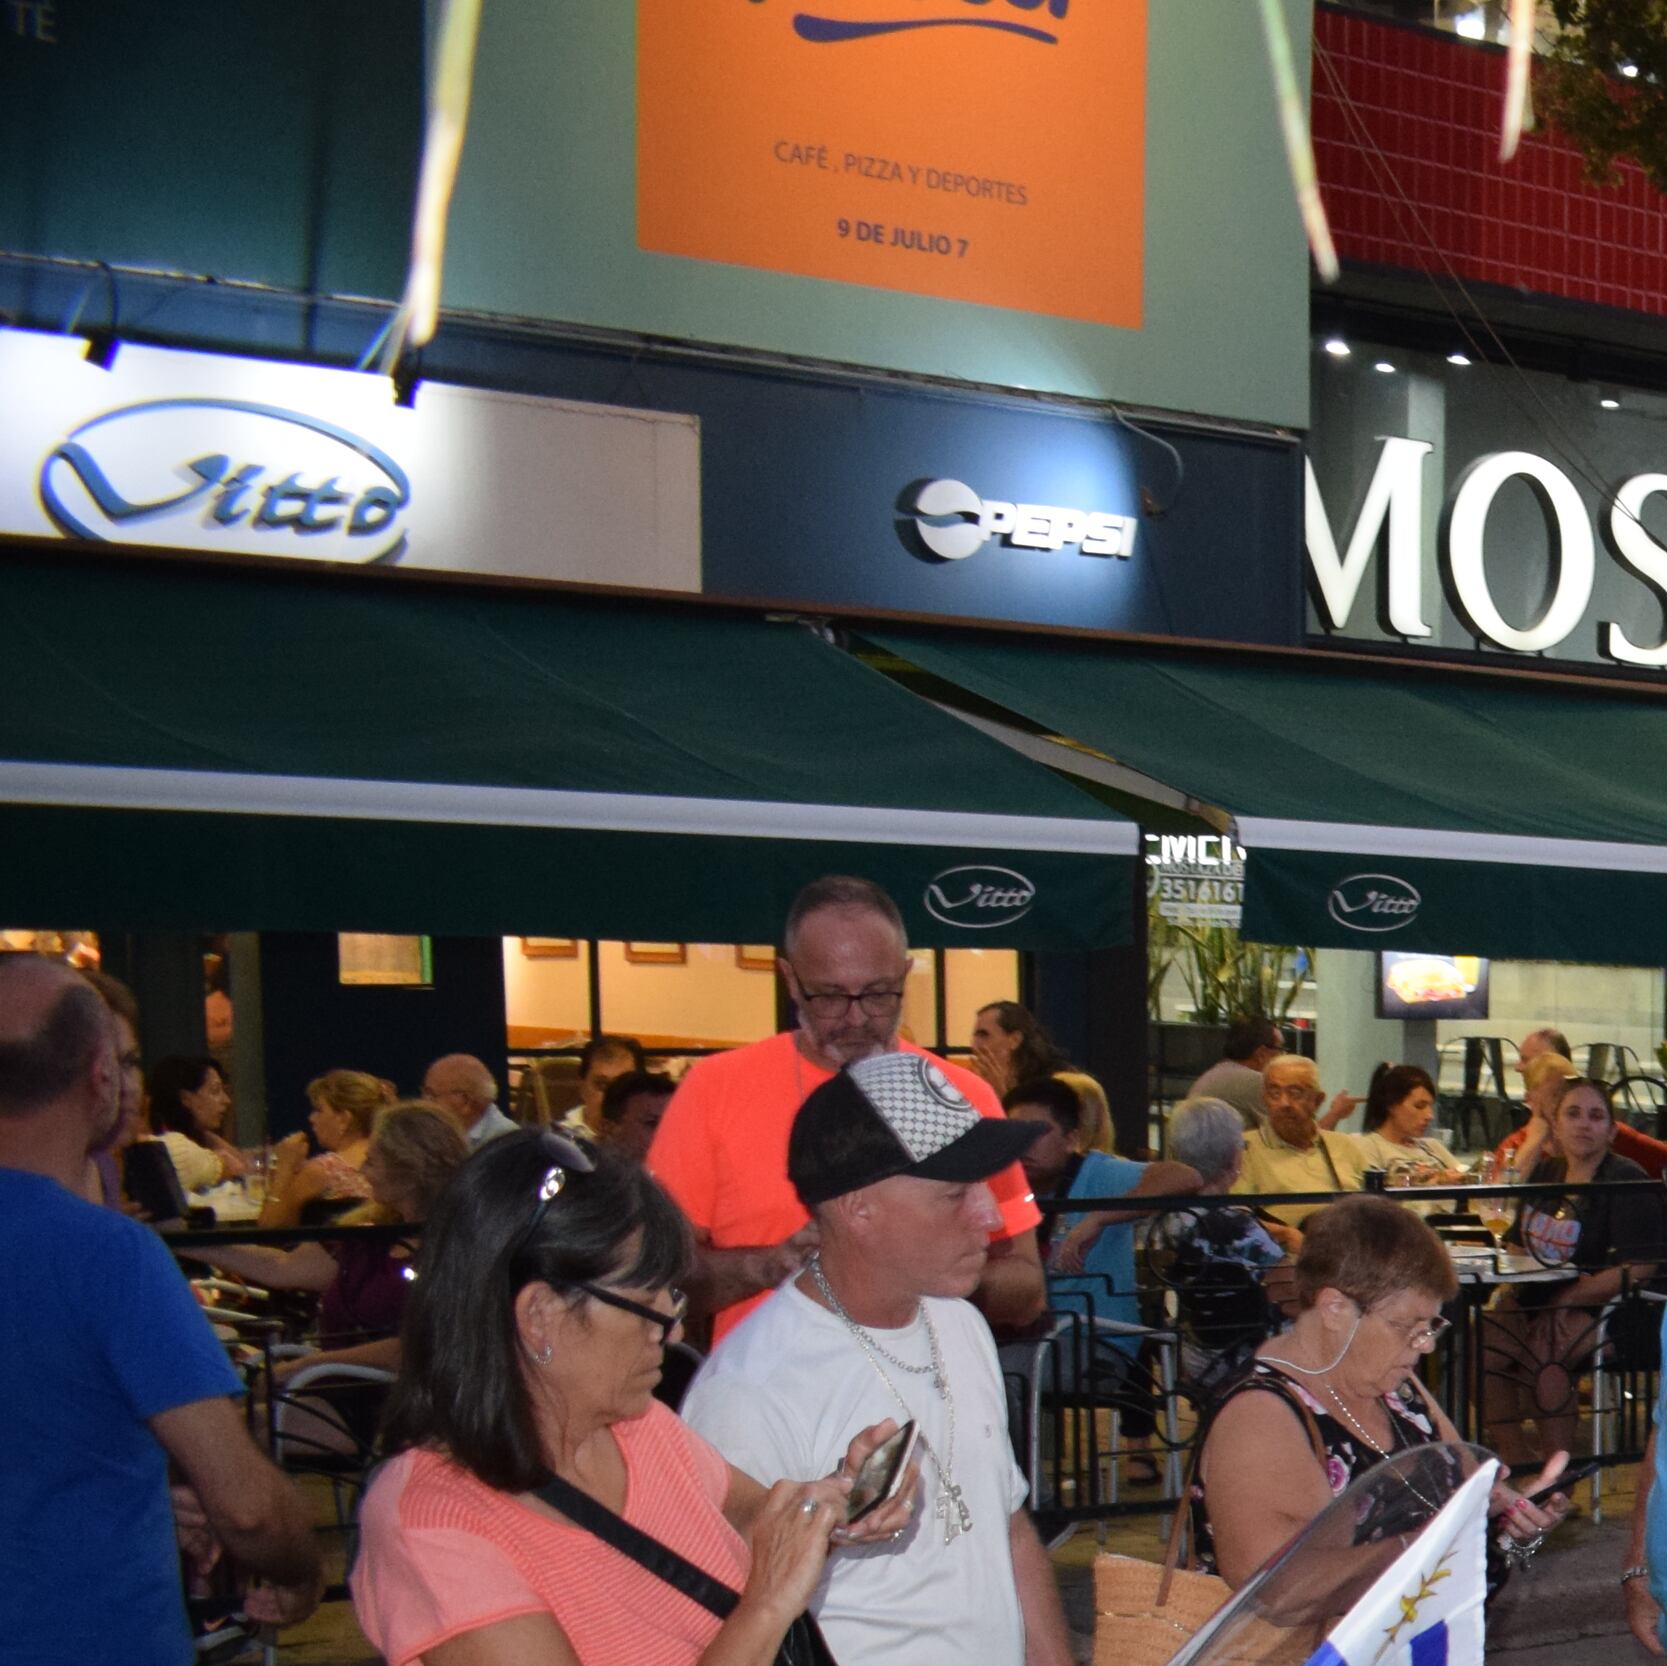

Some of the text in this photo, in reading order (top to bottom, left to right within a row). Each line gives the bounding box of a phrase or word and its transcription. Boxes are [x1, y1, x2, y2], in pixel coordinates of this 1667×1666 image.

[844, 153, 902, 181] PIZZA
[908, 166, 922, 184] Y
[926, 169, 1027, 205] DEPORTES
[838, 219, 968, 258] 9 DE JULIO 7
[52, 442, 400, 536] Vitto
[978, 499, 1138, 557] PEPSI
